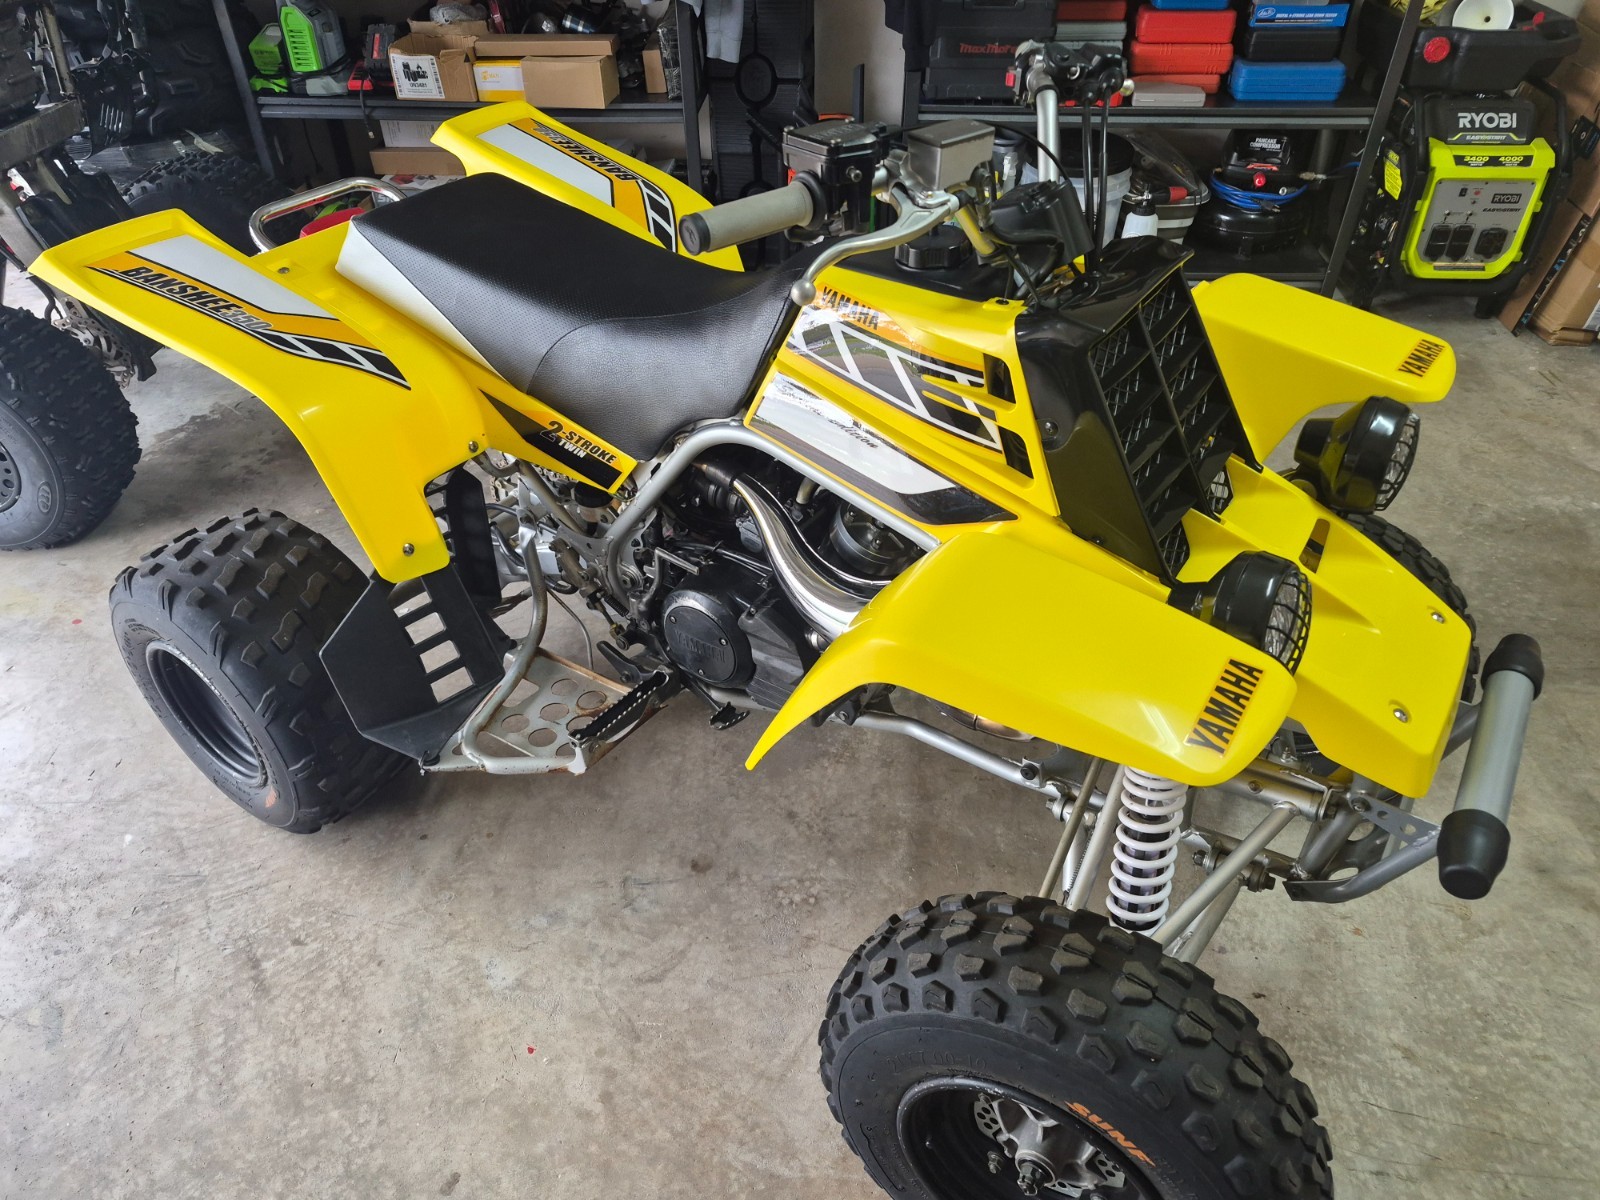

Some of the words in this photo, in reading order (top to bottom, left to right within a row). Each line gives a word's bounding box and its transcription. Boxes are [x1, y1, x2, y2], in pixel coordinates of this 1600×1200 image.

[1457, 112, 1517, 129] RYOBI
[1492, 195, 1520, 203] RYOBI
[822, 286, 880, 331] YAMAHA
[1398, 339, 1445, 378] YAMAHA
[540, 420, 617, 464] 2-STROKE
[558, 438, 588, 459] TWIN
[1185, 659, 1264, 755] YAMAHA
